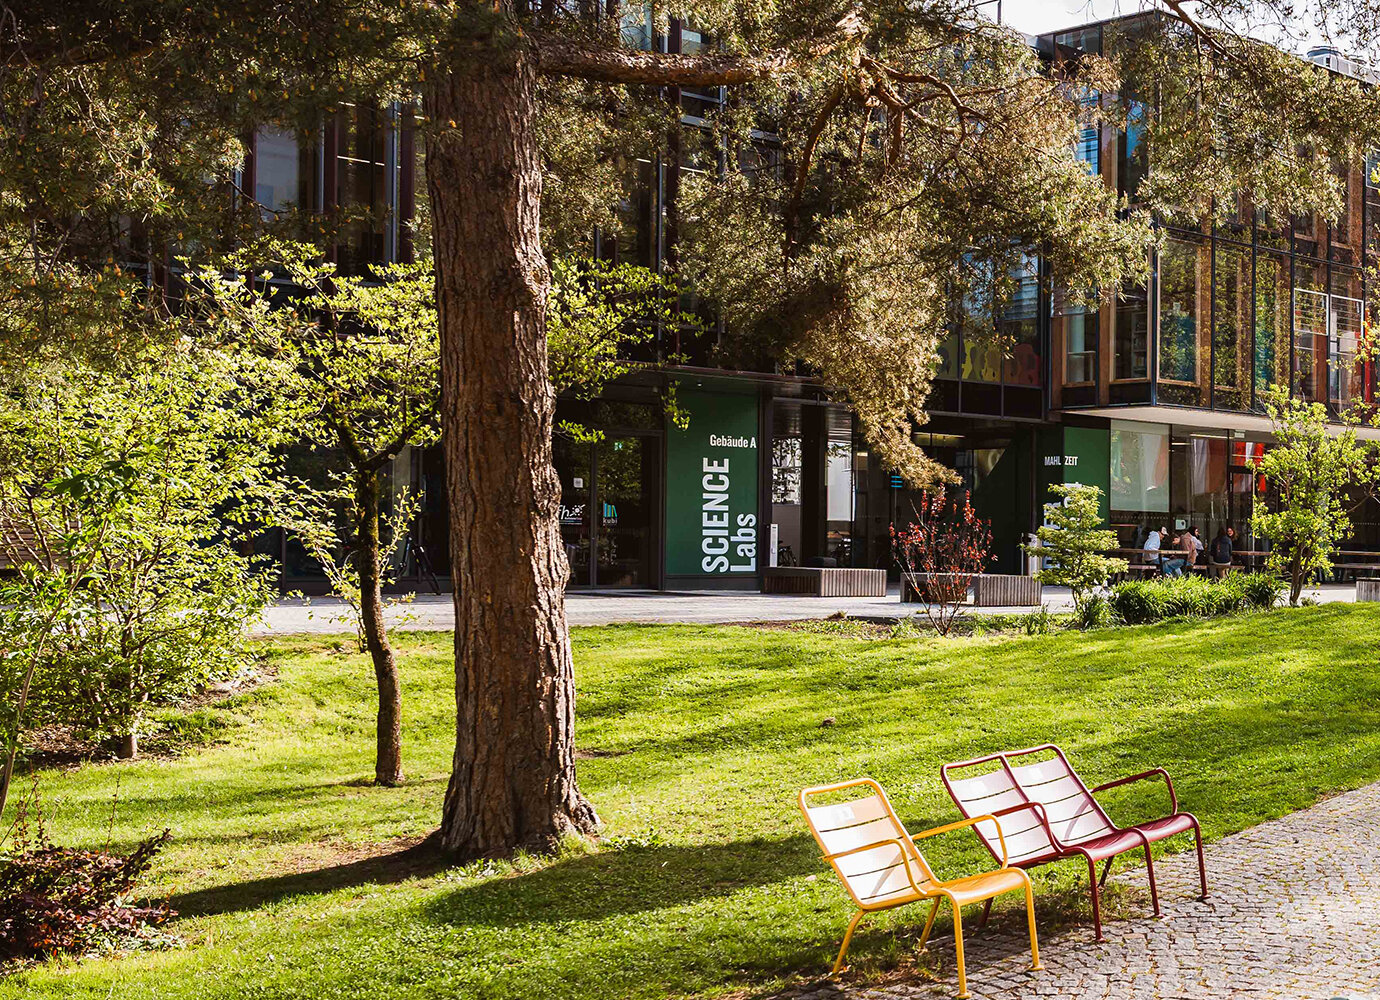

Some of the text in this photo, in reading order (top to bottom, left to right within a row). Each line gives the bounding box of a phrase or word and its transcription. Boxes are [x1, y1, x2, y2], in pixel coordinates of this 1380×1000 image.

[709, 434, 757, 448] Gebäude A
[1044, 455, 1079, 466] MAHL ZEIT
[702, 457, 730, 573] SCIENCE
[730, 513, 757, 572] Labs
